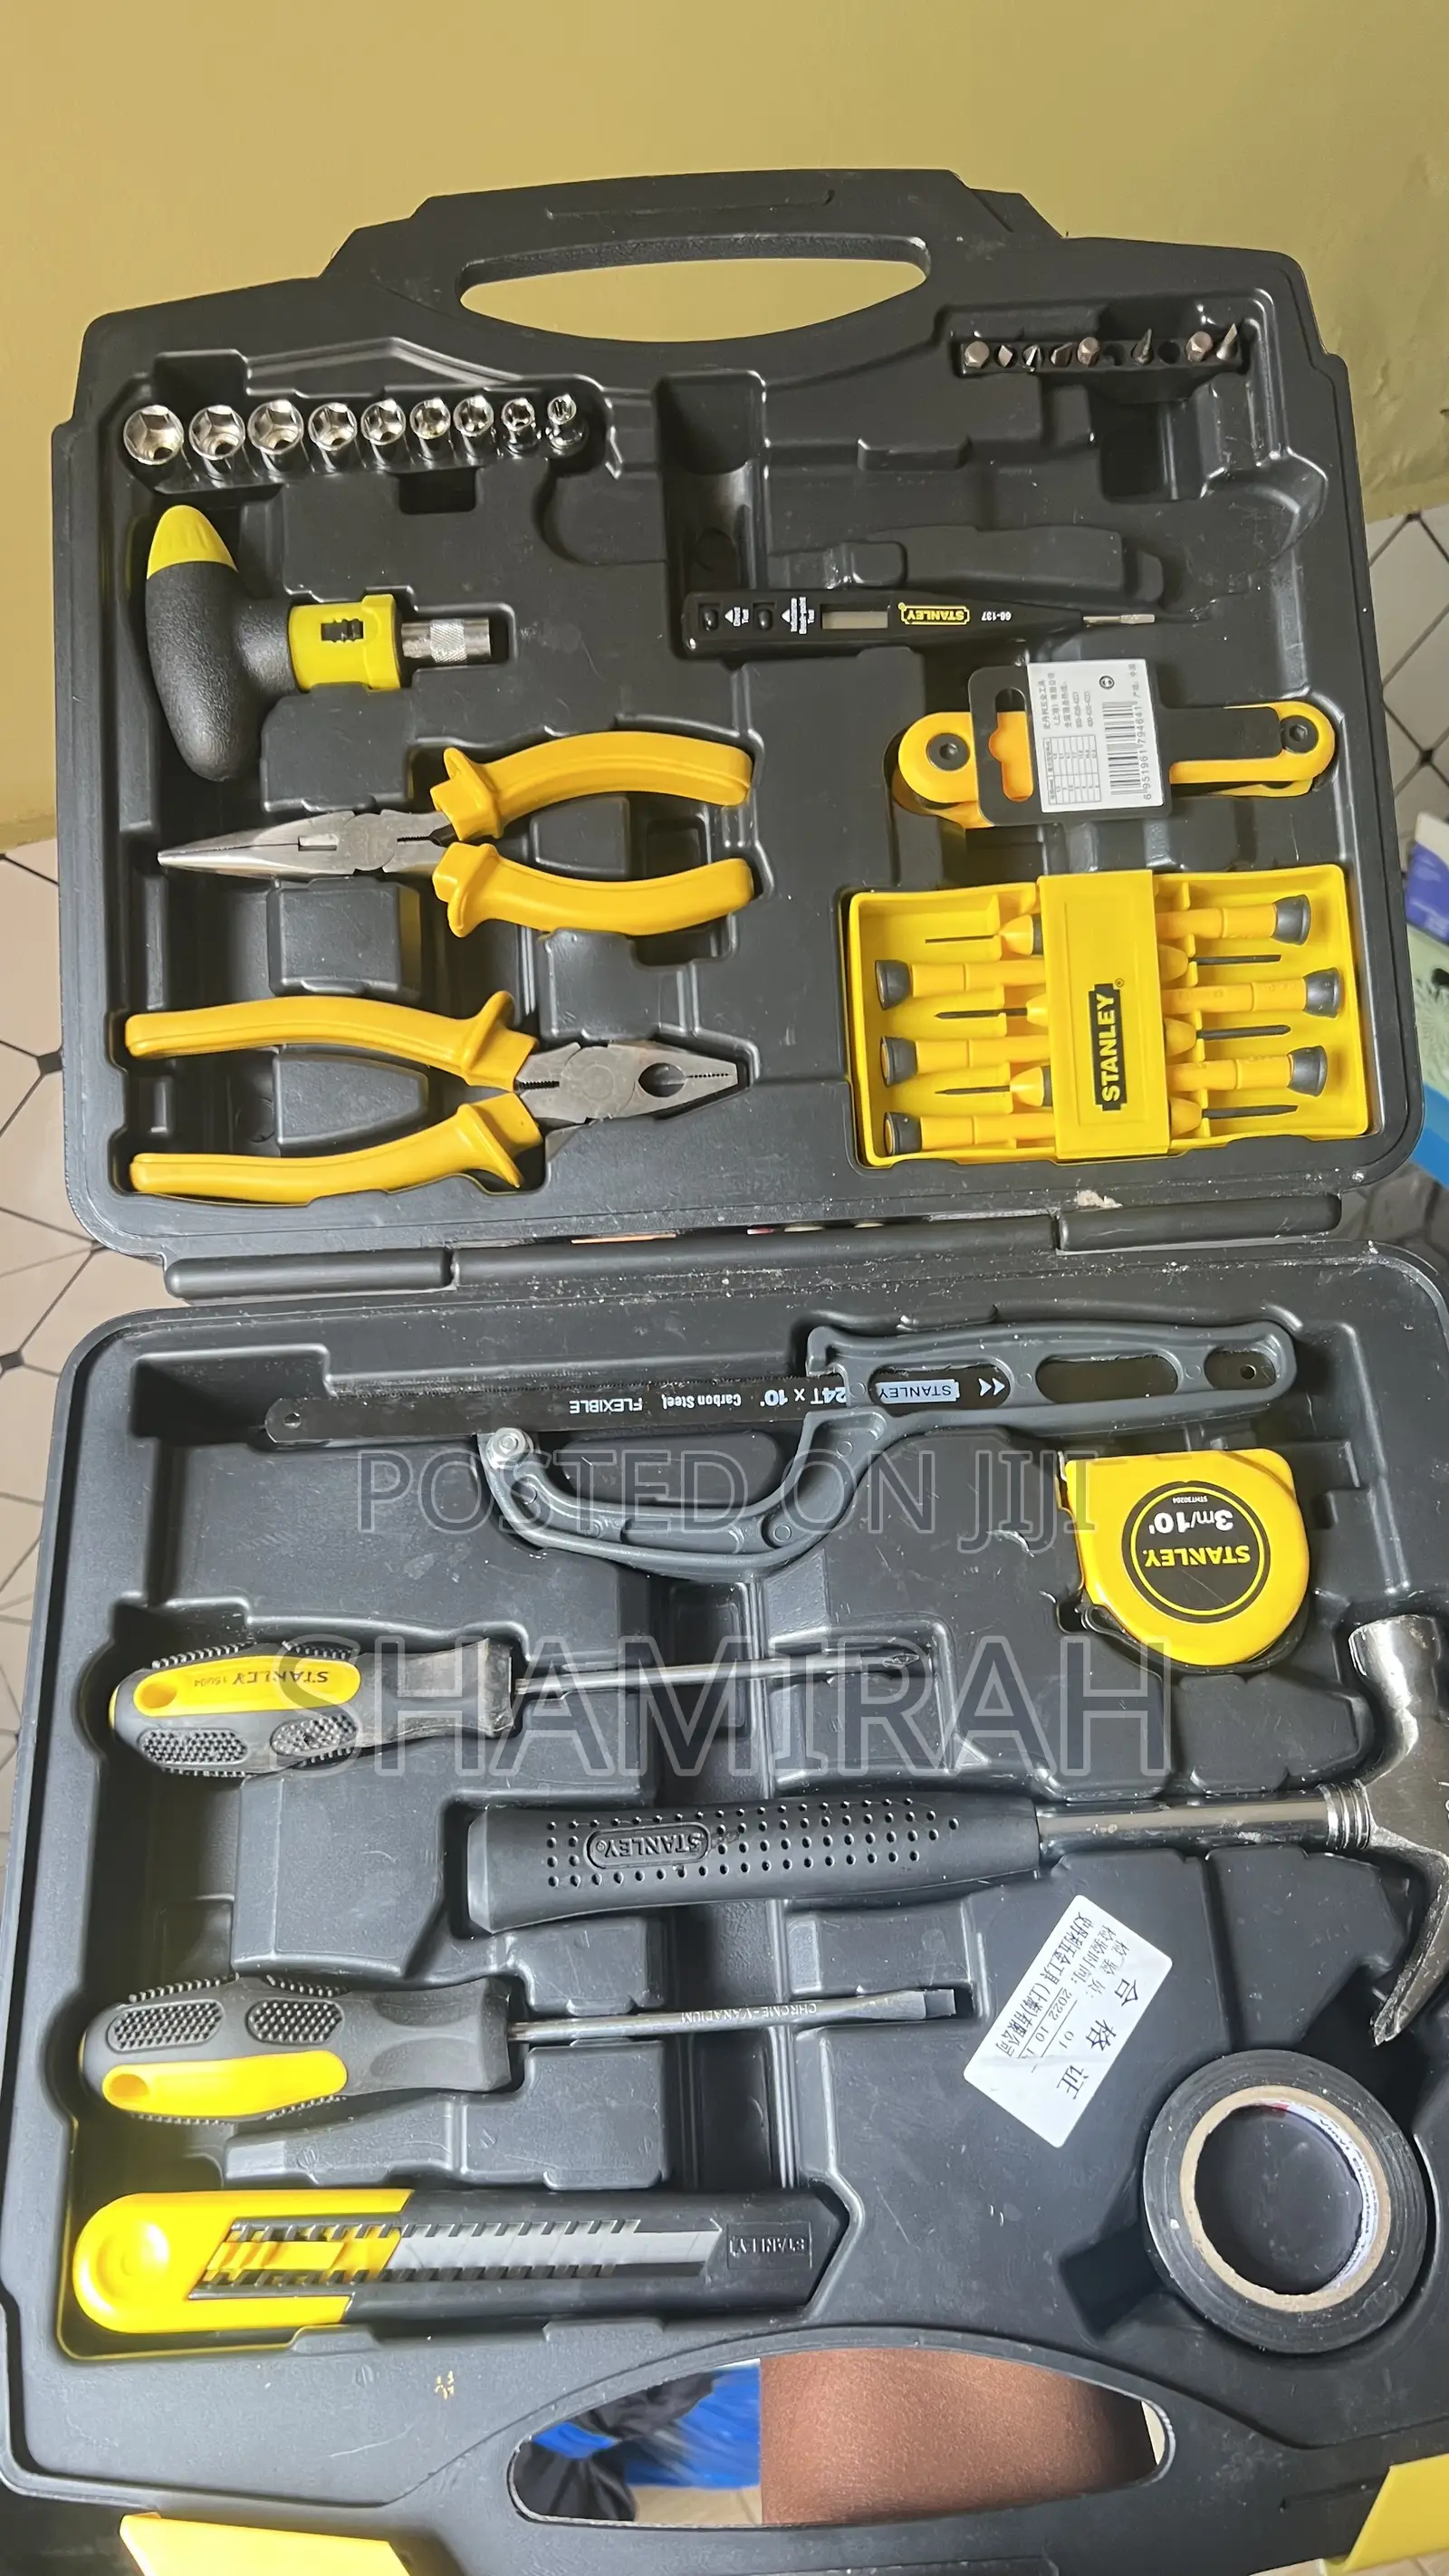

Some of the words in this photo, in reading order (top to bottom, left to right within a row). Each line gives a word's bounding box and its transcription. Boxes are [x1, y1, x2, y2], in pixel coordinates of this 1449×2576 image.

[907, 609, 965, 621] STANLEY
[1096, 992, 1121, 1102] STANLEY
[697, 1393, 742, 1408] Carbon
[810, 1386, 847, 1404] 24T
[878, 1384, 952, 1399] STANLEY
[569, 1397, 643, 1414] FLEXIBLE
[661, 1393, 695, 1410] Steel
[604, 1832, 704, 1858] STANLEY
[1048, 1987, 1073, 2021] 2022
[680, 2002, 818, 2025] CHROME-VANADIUM
[739, 2236, 805, 2254] STANLEY
